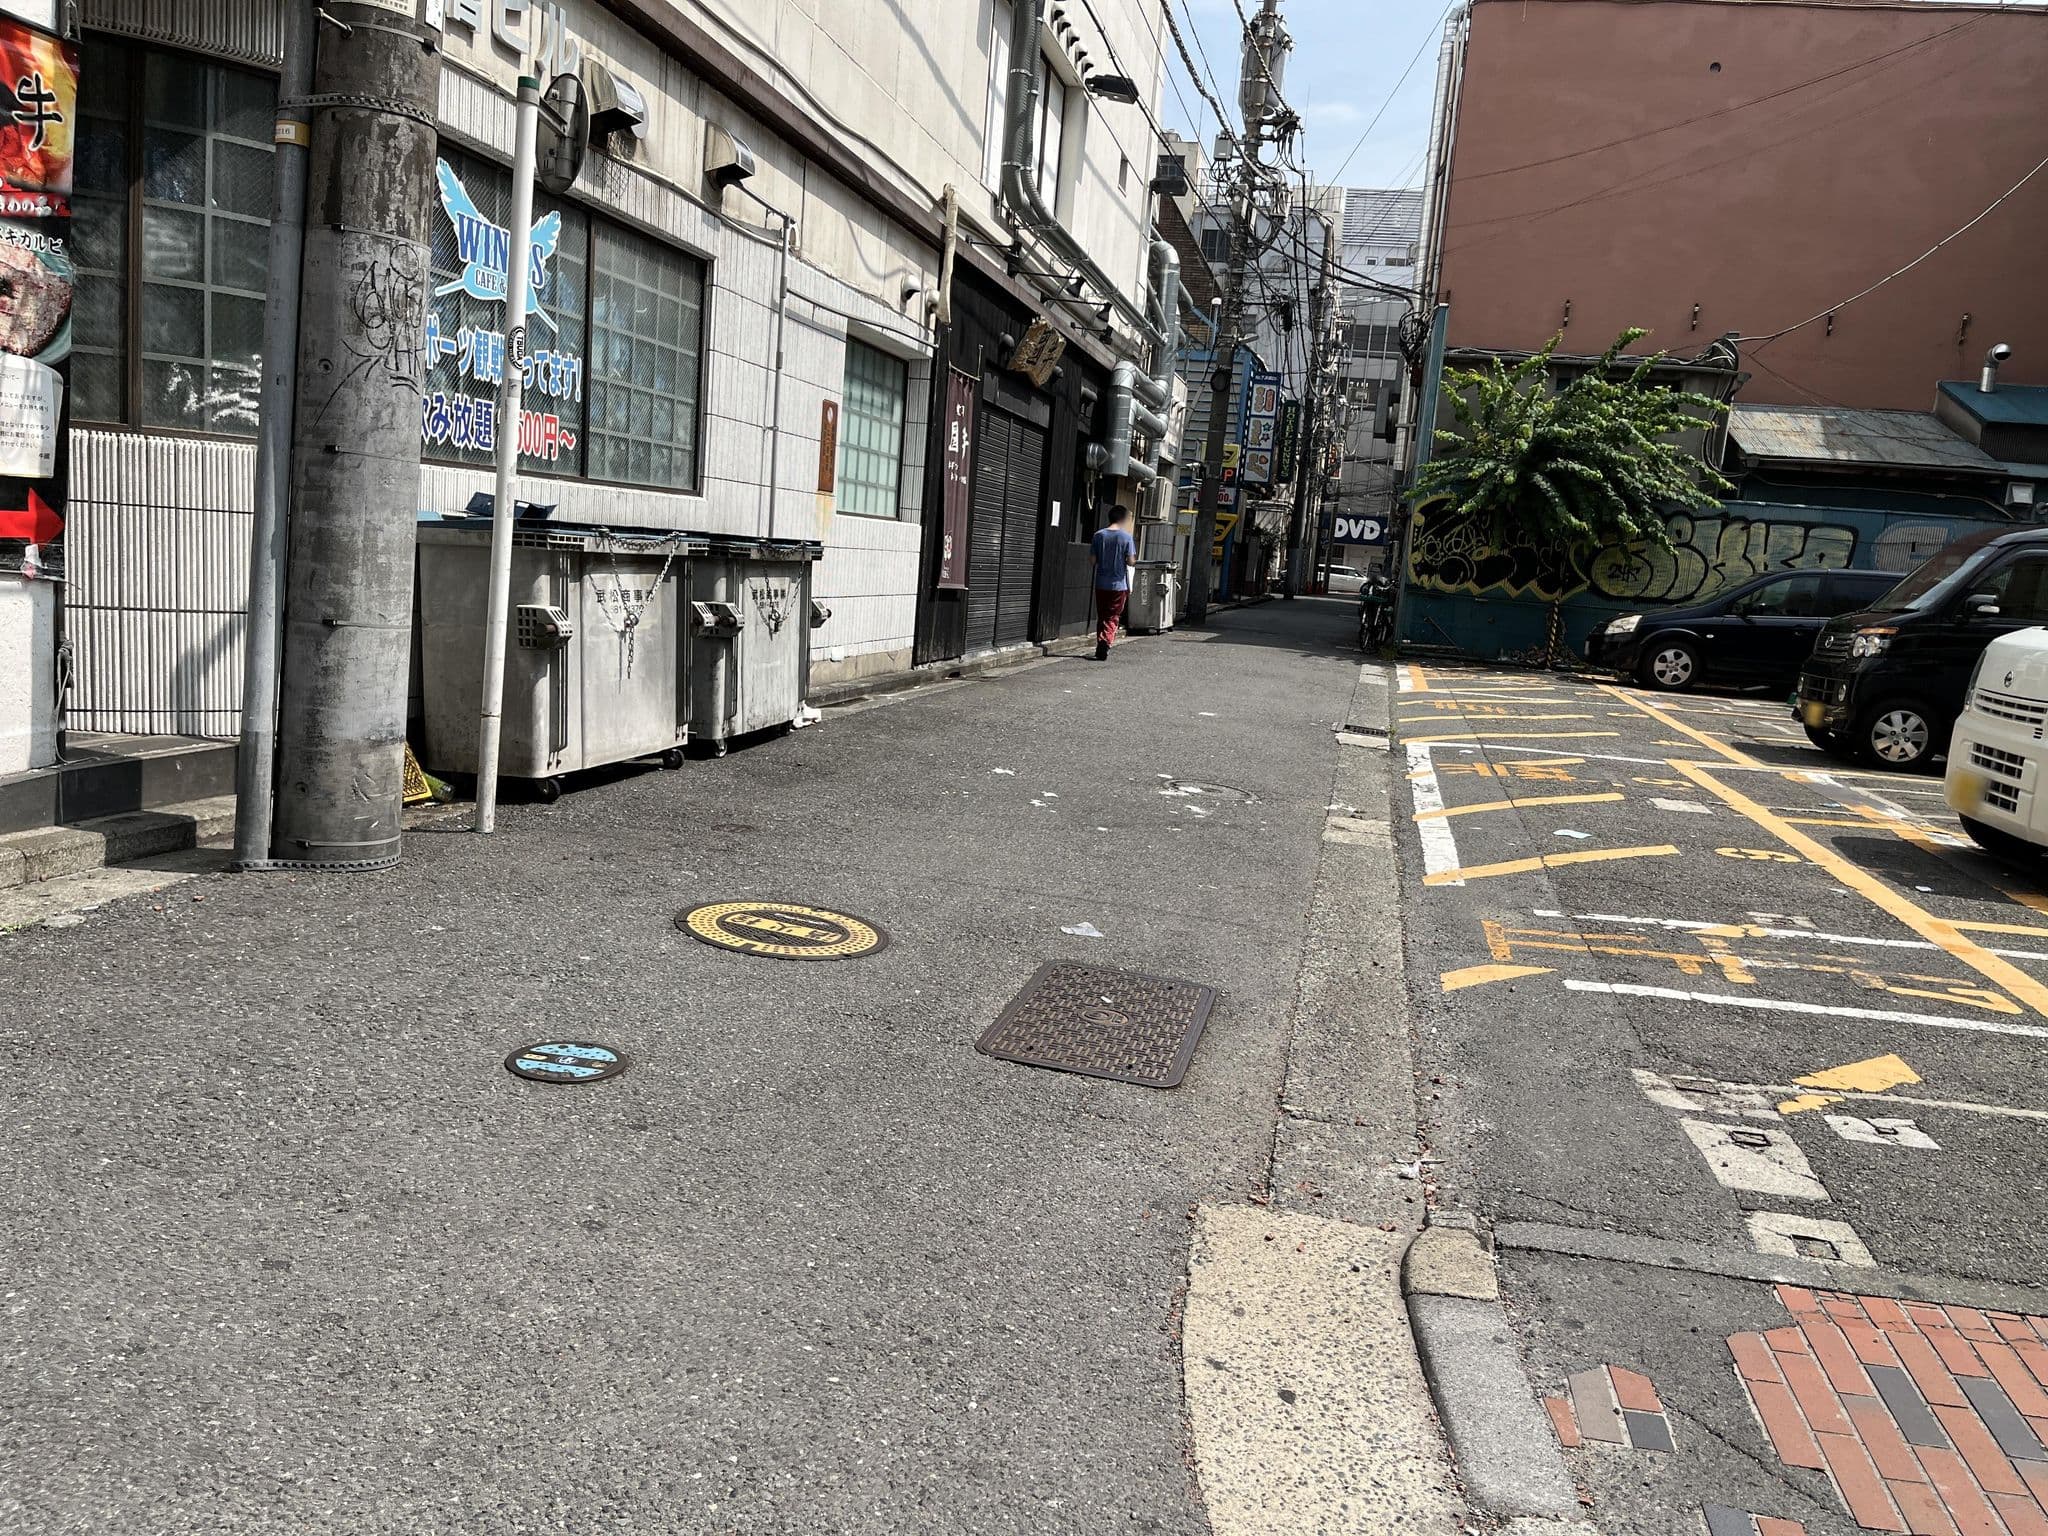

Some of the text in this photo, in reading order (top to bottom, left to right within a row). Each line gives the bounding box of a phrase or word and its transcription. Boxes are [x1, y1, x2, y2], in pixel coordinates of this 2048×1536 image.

[12, 71, 64, 150] 牛
[457, 212, 544, 287] WINS
[476, 269, 497, 291] CAFE
[1334, 517, 1380, 541] DVD
